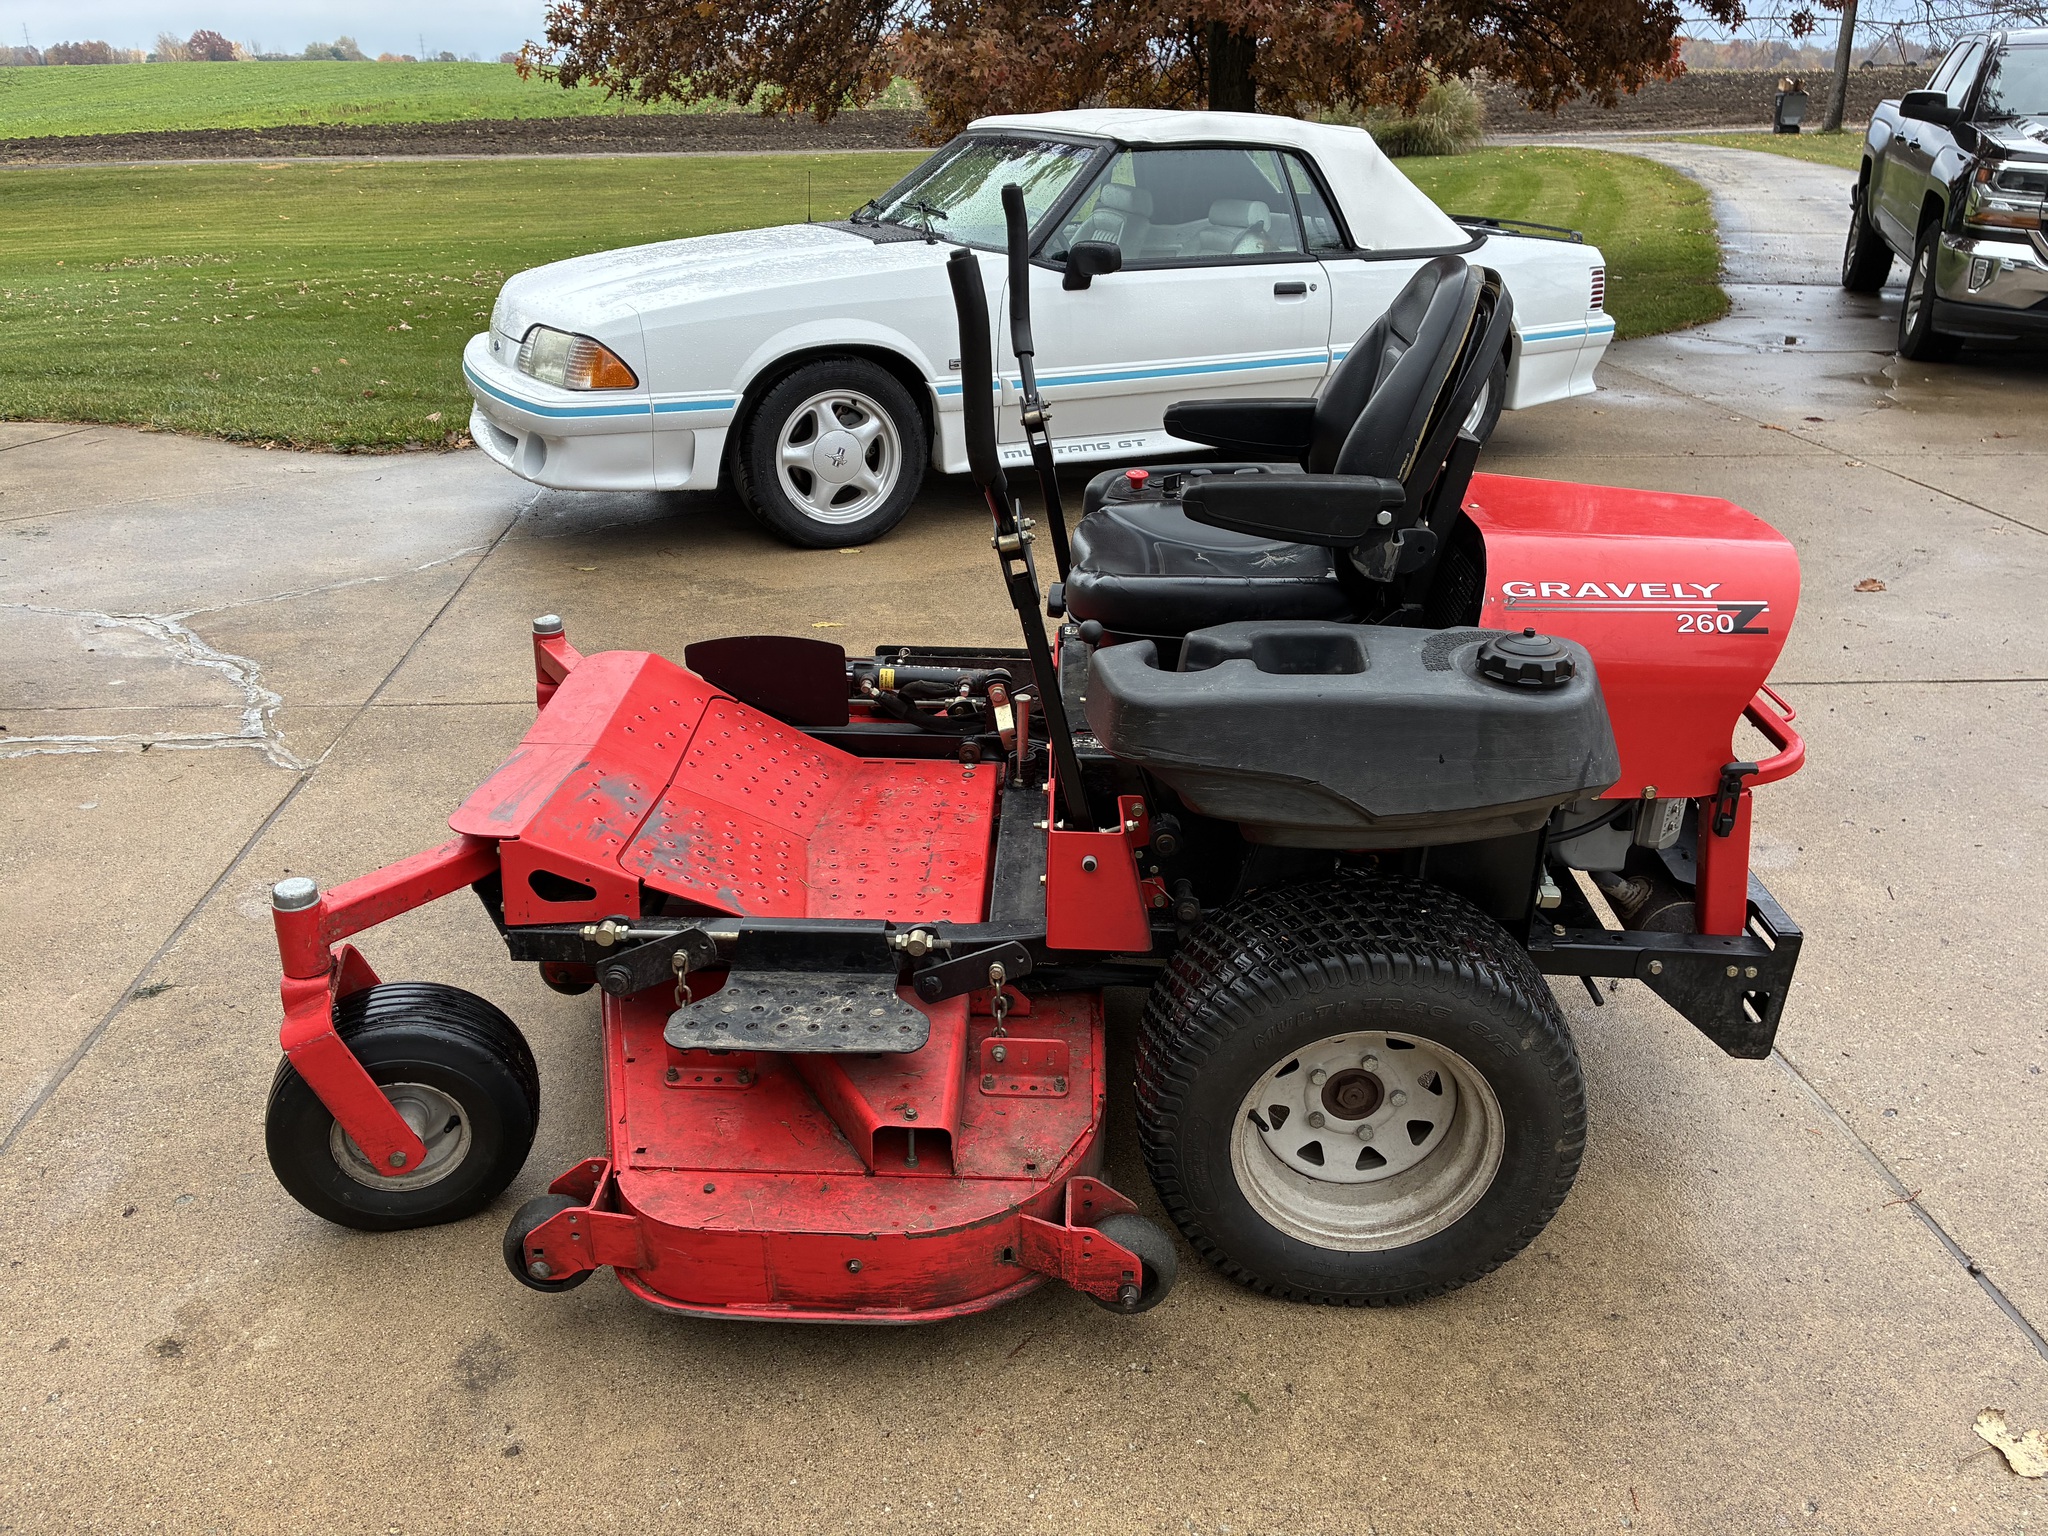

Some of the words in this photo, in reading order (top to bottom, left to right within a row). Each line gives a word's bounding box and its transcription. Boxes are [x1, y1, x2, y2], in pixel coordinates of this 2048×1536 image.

[1003, 441, 1111, 458] MUTANG
[1117, 438, 1147, 449] GT
[1501, 581, 1722, 599] GRAVELY
[1253, 1000, 1348, 1050] MULTI
[1360, 997, 1453, 1019] TRAC
